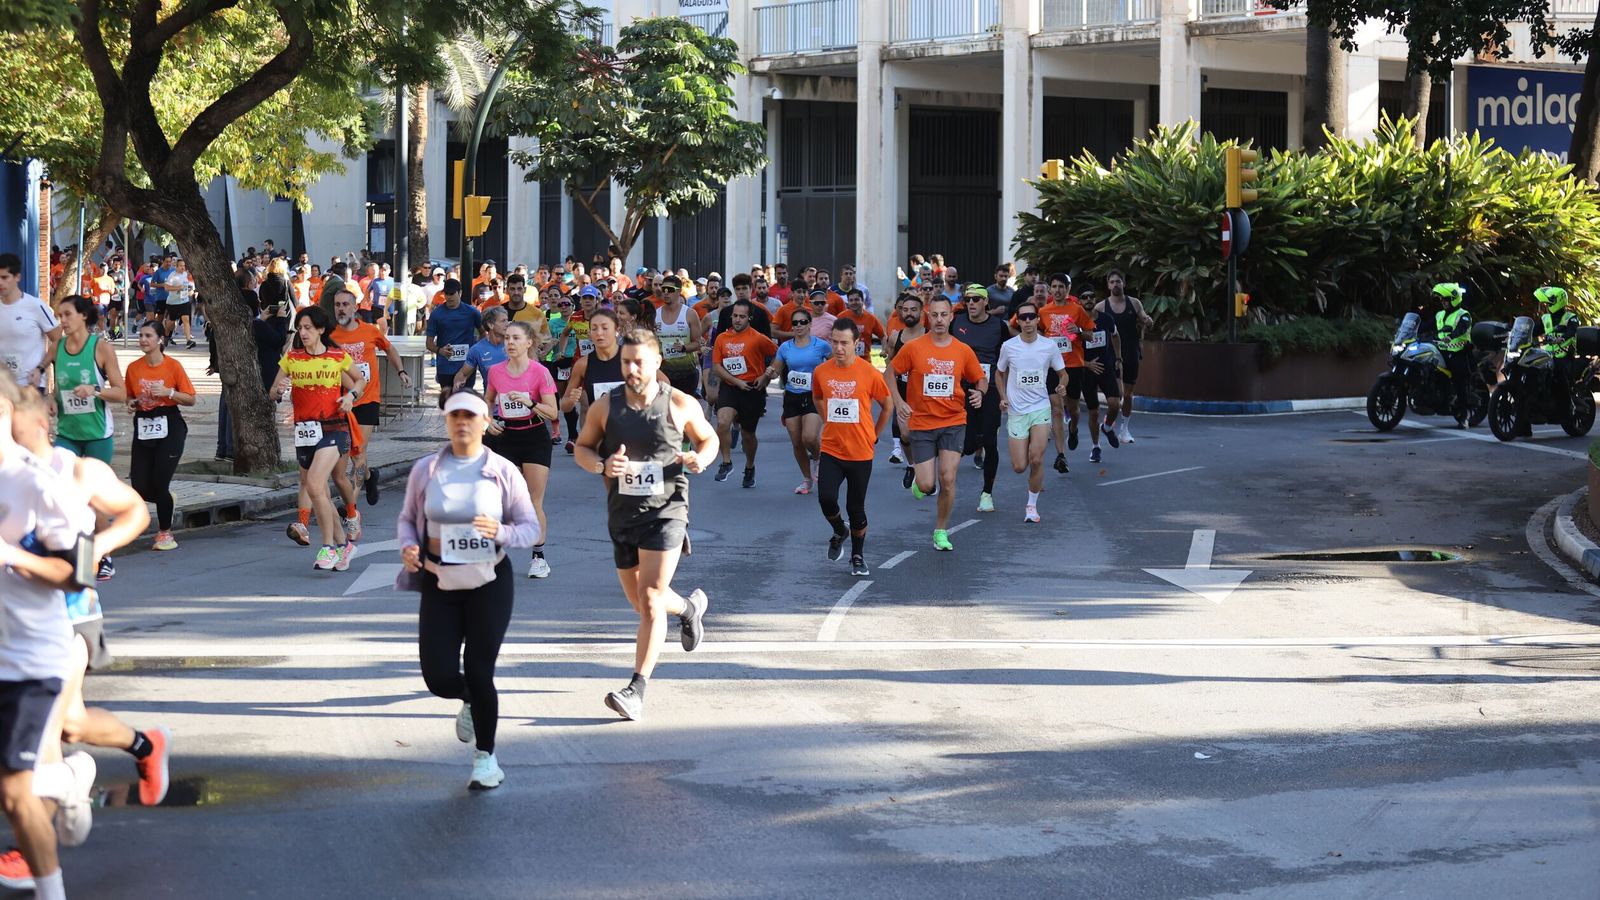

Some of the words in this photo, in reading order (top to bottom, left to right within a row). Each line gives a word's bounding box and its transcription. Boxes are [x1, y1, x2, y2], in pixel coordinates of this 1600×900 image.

[727, 363, 742, 371] 503
[790, 377, 807, 385] 408
[1021, 376, 1039, 384] 339
[927, 382, 948, 390] 666
[67, 398, 88, 407] 106
[504, 402, 524, 410] 989
[834, 407, 849, 416] 46
[142, 424, 162, 433] 773
[298, 429, 316, 439] 942
[625, 473, 655, 485] 614
[448, 538, 489, 550] 1966
